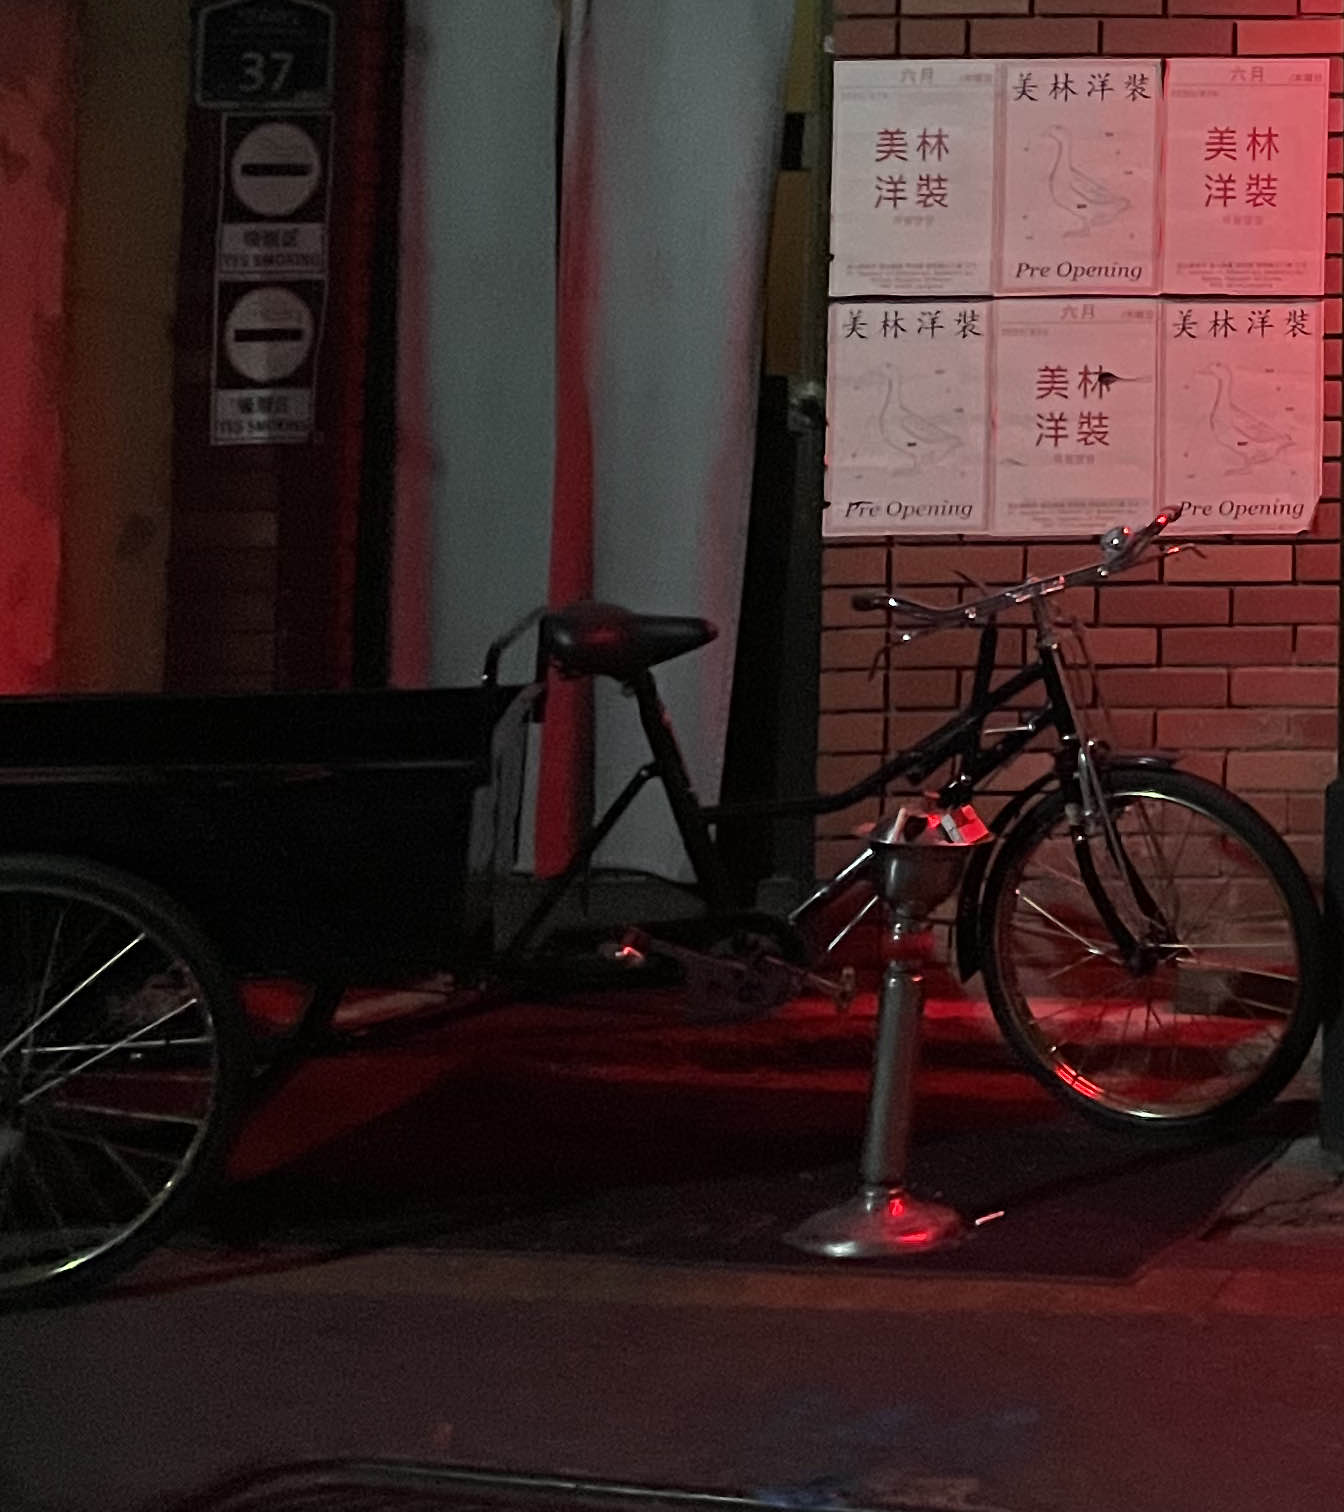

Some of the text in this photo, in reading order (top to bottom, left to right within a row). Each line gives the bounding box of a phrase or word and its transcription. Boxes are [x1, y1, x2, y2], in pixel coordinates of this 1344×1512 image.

[239, 52, 295, 92] 37
[1012, 71, 1152, 102] 美林洋裝
[875, 127, 950, 163] 美林
[1204, 126, 1280, 162] 美林
[874, 173, 950, 209] 洋裝
[1203, 173, 1278, 209] 洋裝
[1016, 261, 1143, 282] Pre Opening
[842, 309, 984, 339] 美林洋裝
[1171, 308, 1313, 339] 美林洋裝
[1035, 364, 1111, 400] 美林
[1035, 410, 1111, 448] 洋裝
[845, 500, 973, 521] Pre Opening
[1180, 498, 1305, 521] Pre Opening
